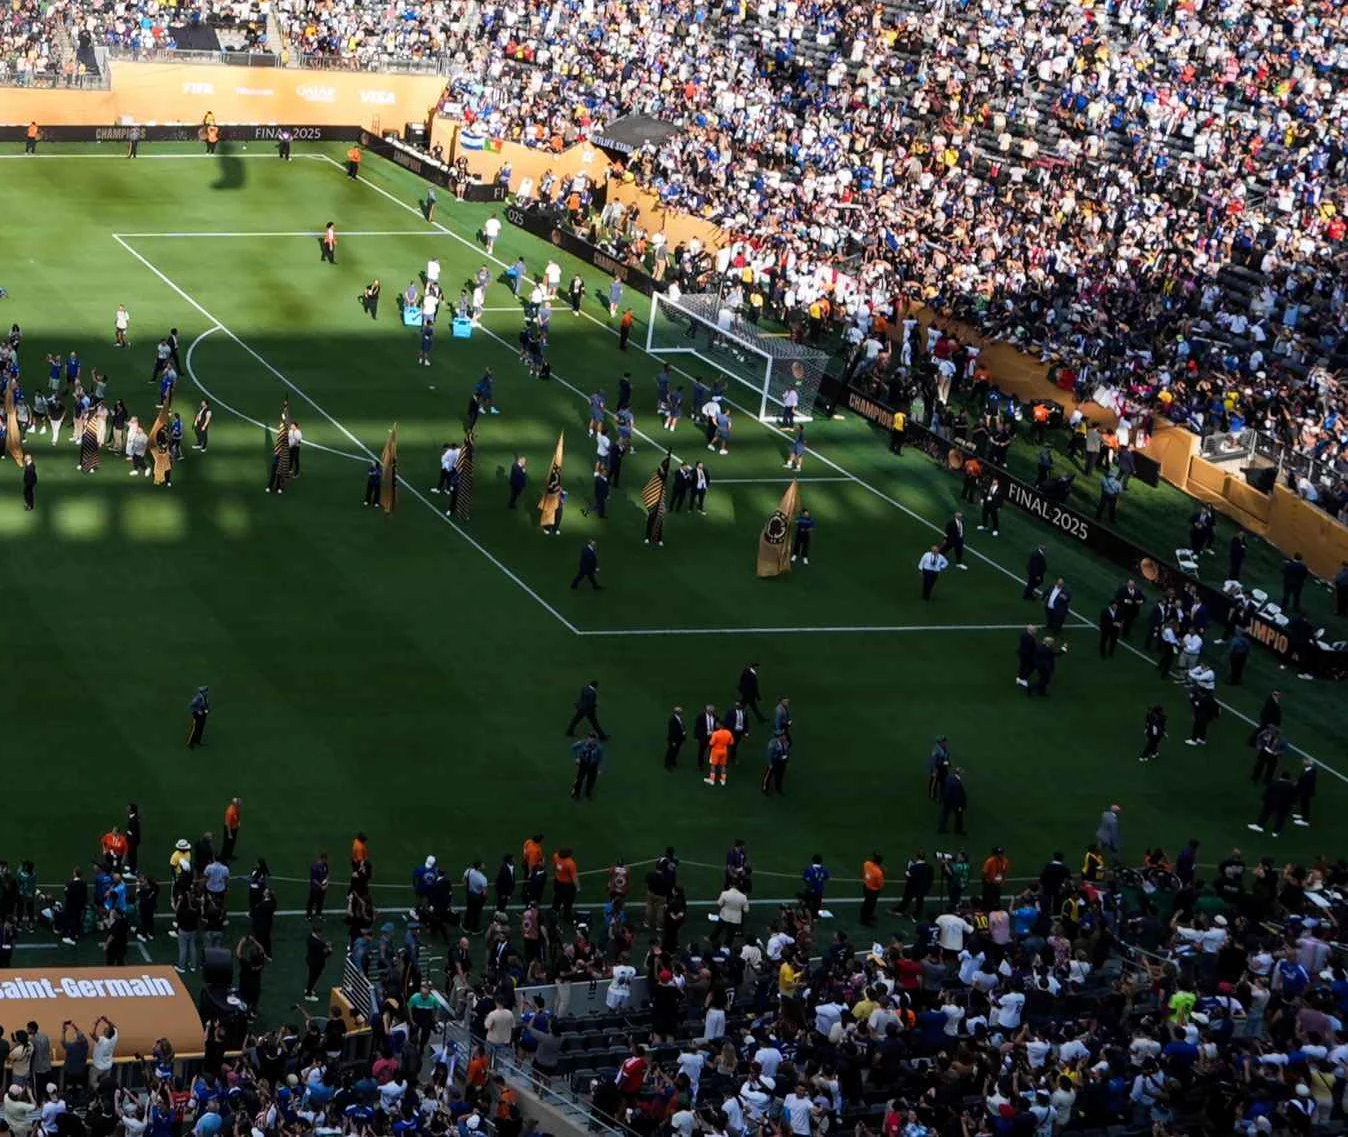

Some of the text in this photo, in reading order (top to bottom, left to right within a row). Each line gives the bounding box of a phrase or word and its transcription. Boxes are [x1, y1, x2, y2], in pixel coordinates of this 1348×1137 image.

[255, 128, 321, 139] FINA 2025
[508, 209, 524, 225] 025
[849, 392, 894, 430] CHAMPION
[1009, 483, 1089, 540] FINAL 2025
